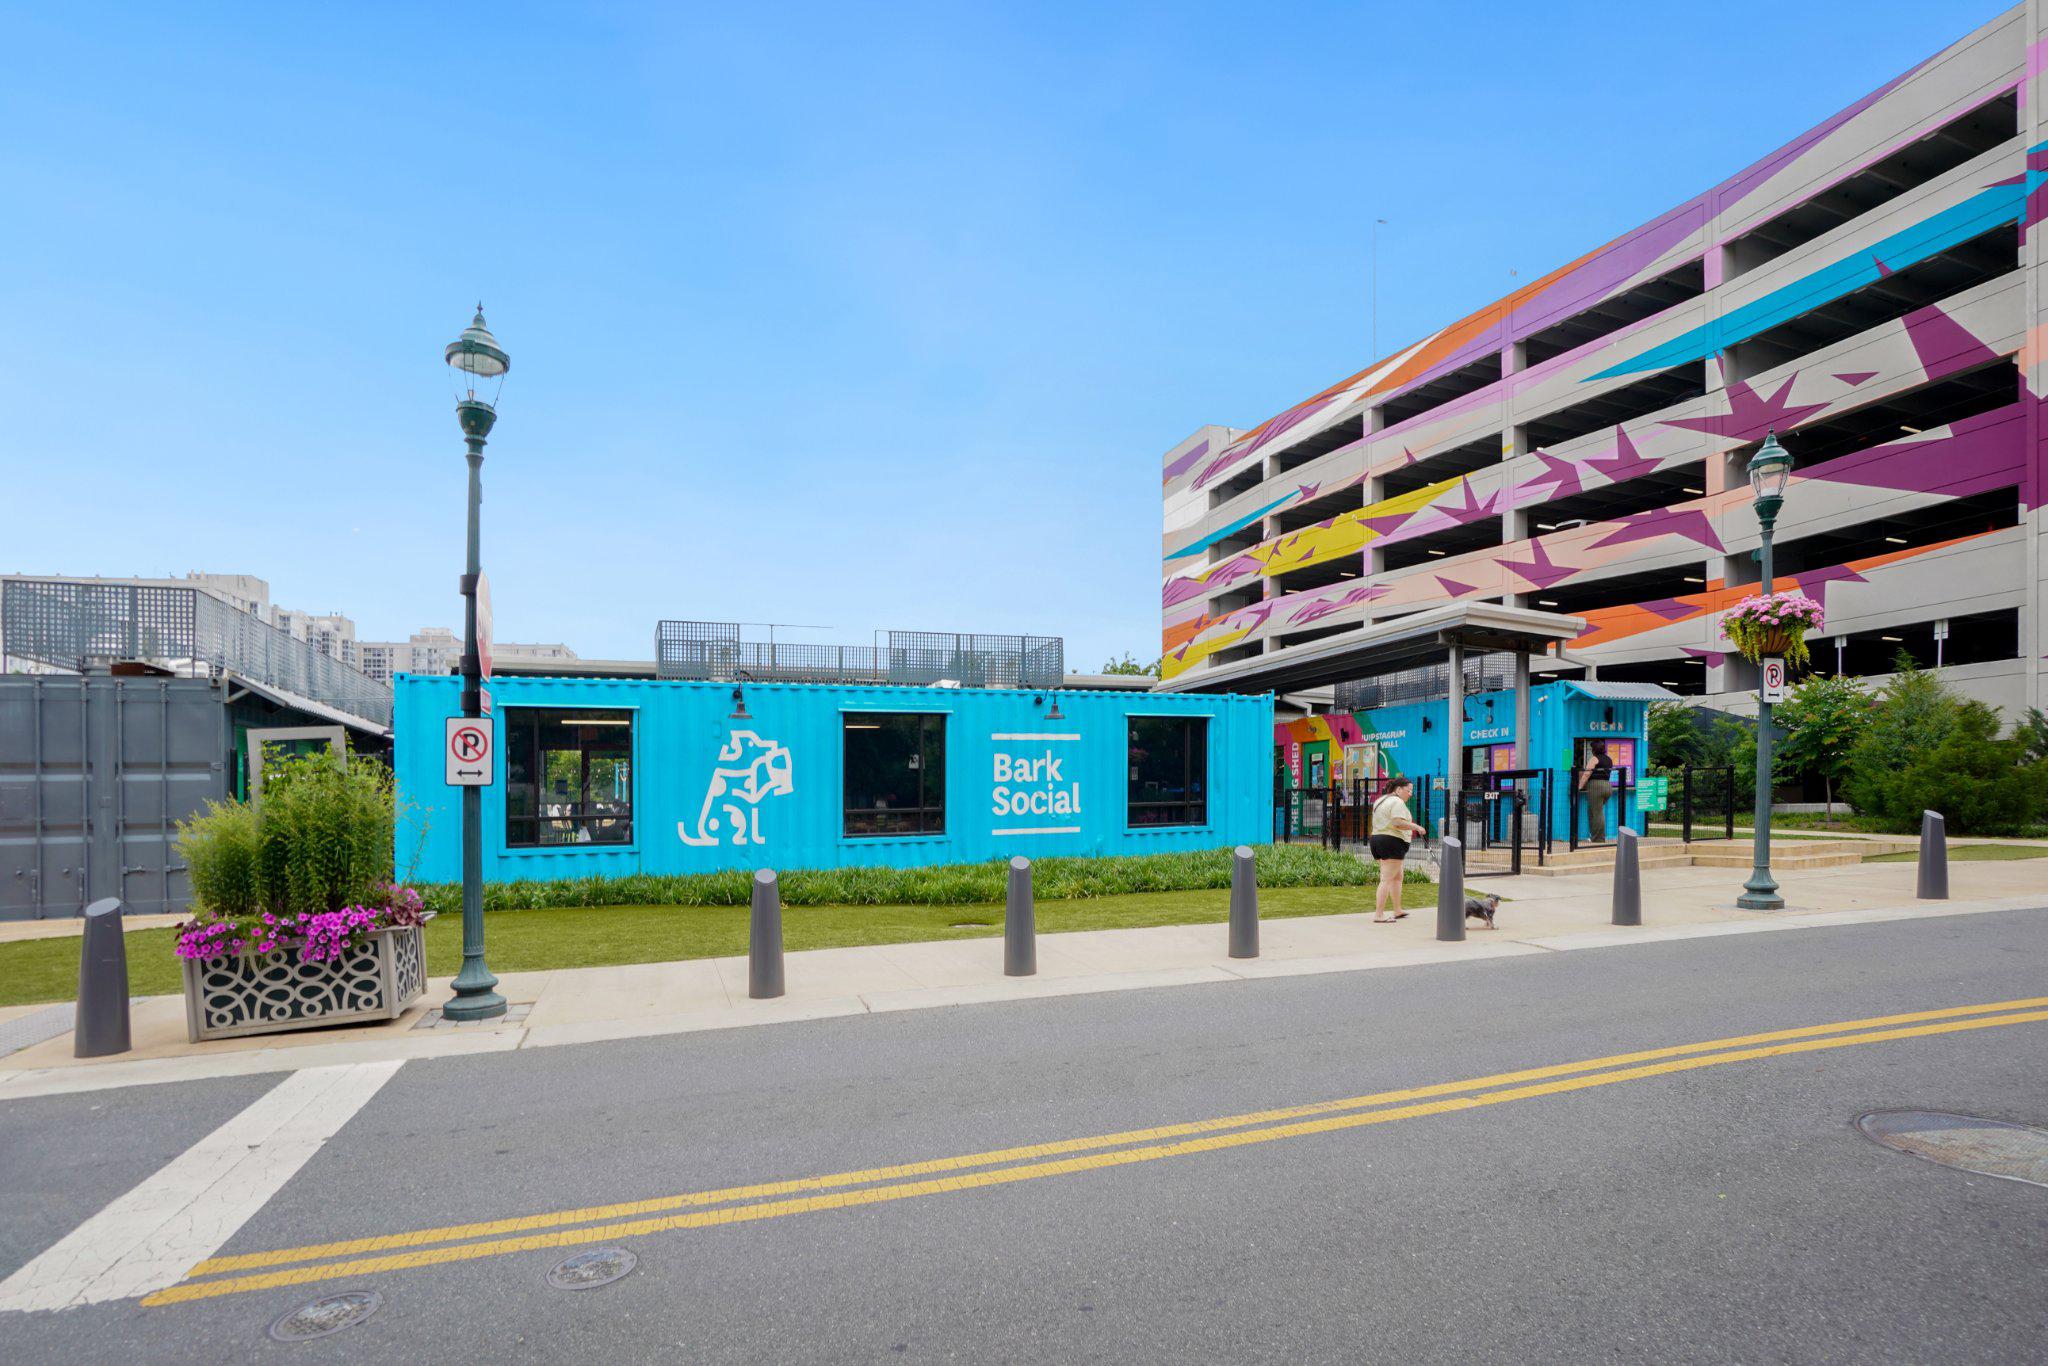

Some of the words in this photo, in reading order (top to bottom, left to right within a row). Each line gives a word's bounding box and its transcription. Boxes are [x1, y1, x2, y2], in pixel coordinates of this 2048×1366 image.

[1380, 740, 1399, 749] WALL
[1470, 728, 1499, 740] CHECK
[1501, 727, 1509, 737] IN
[993, 749, 1063, 782] Bark
[1291, 742, 1299, 776] SHED
[991, 782, 1081, 816] Social
[1291, 778, 1299, 806] DOG
[1484, 791, 1500, 800] EXIT
[1291, 807, 1299, 833] THE
